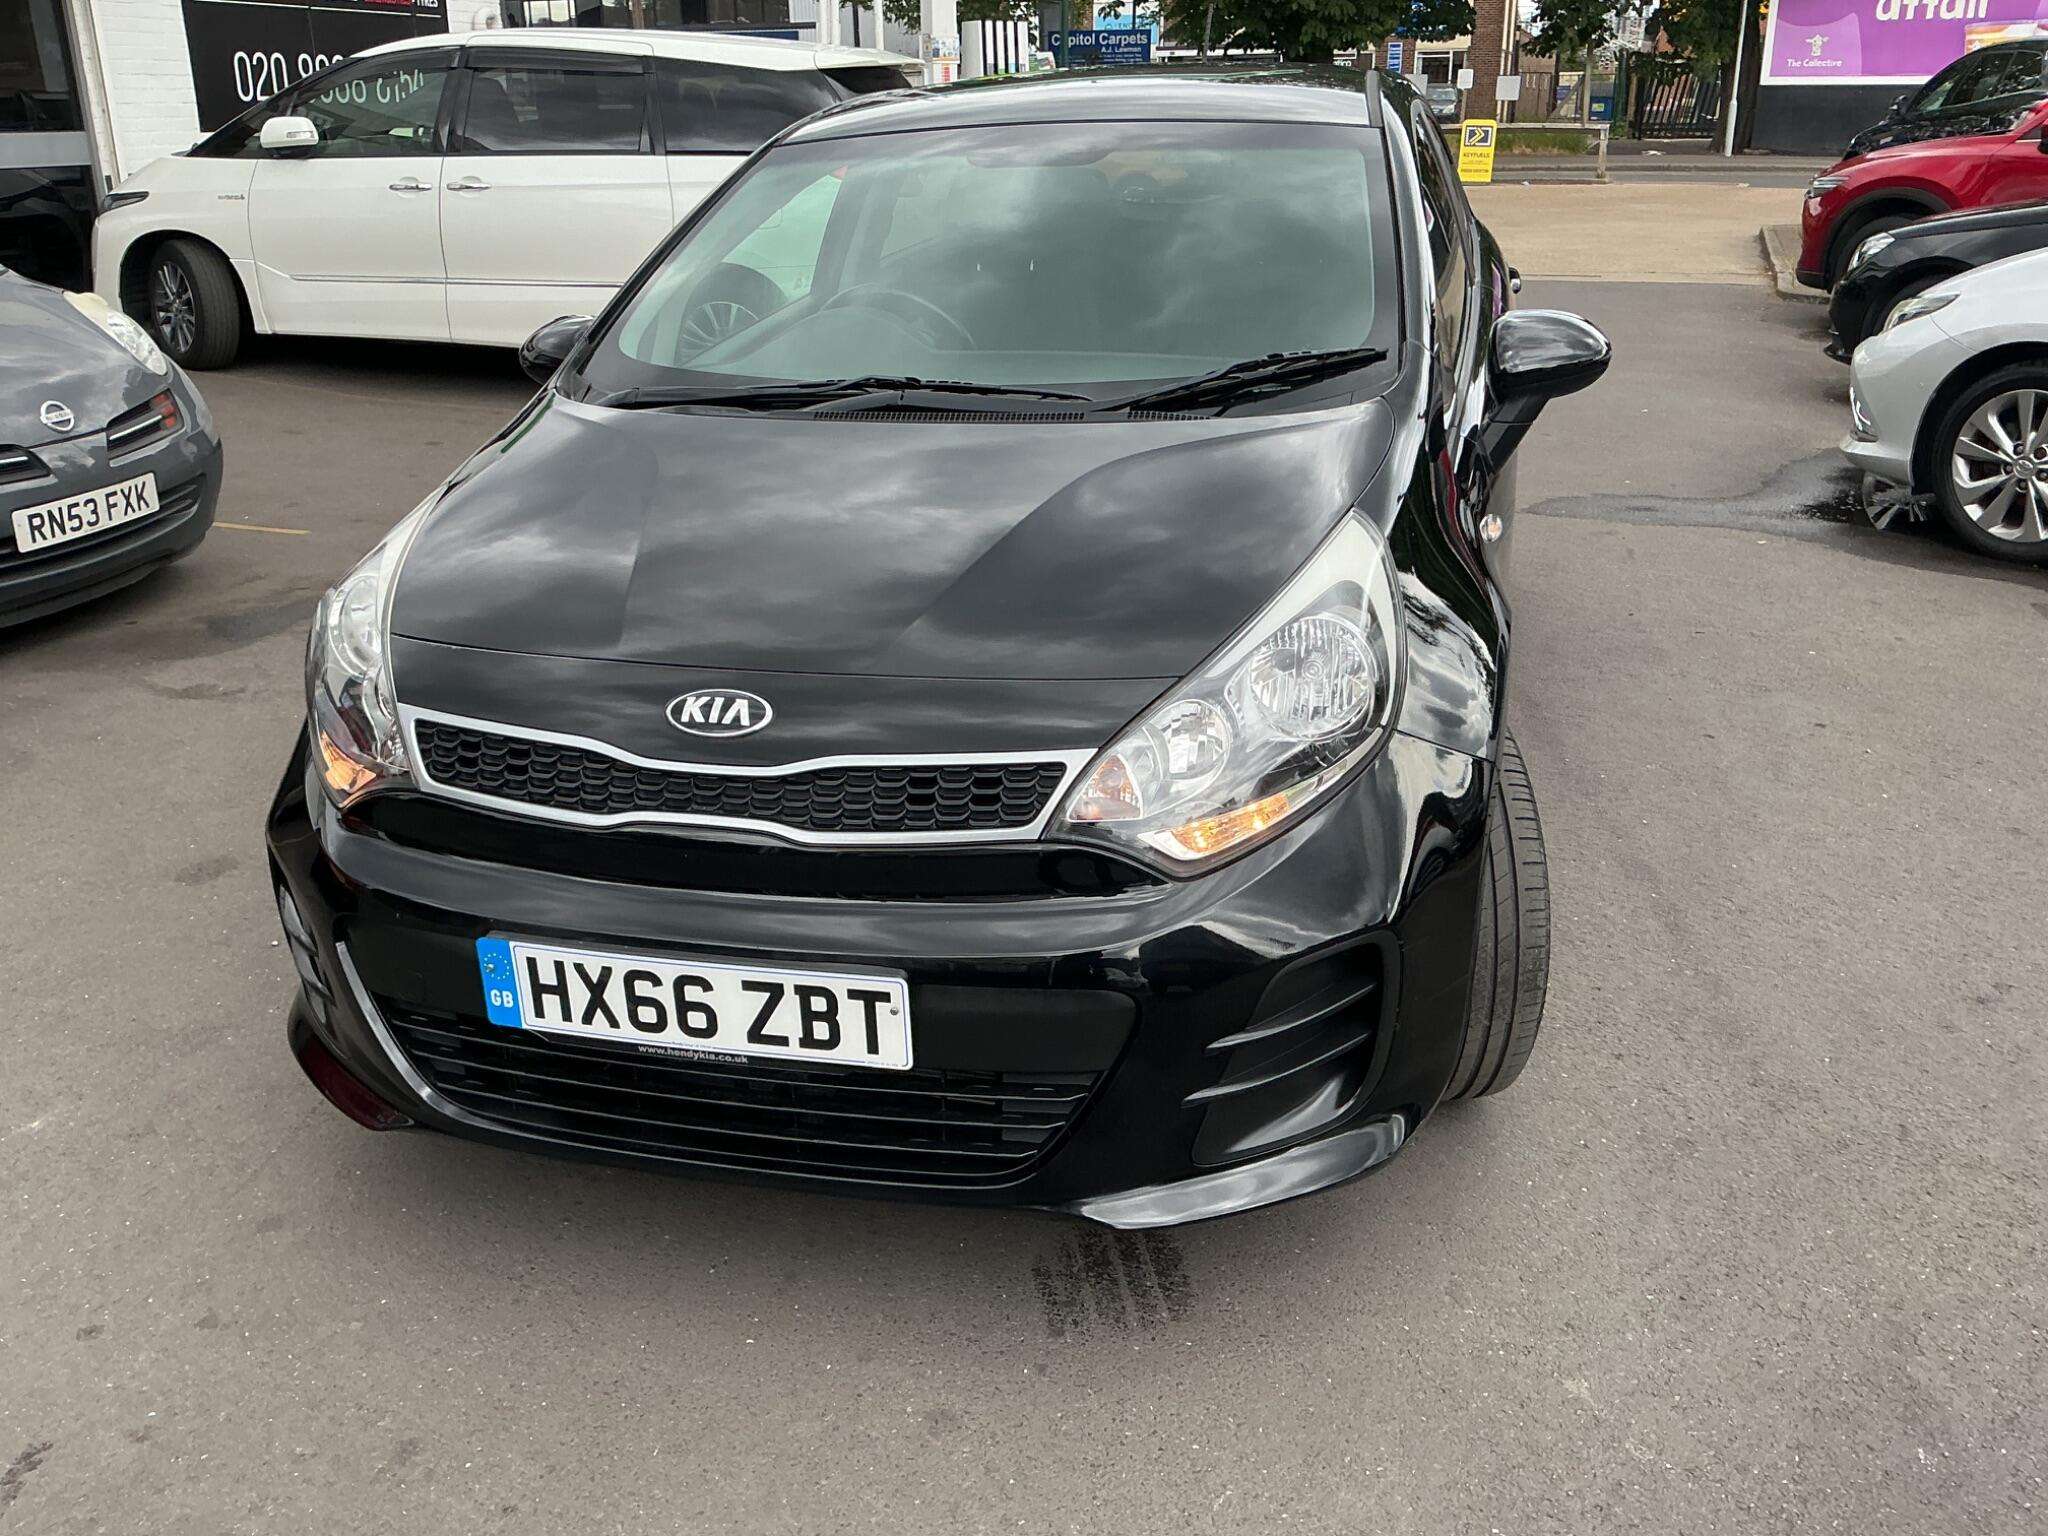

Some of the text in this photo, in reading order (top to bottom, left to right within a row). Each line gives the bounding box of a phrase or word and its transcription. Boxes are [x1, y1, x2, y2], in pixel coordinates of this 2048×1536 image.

[1051, 33, 1148, 48] Cpitol Carpets
[1786, 59, 1842, 67] The Collective
[234, 51, 289, 101] 020
[28, 481, 150, 544] RN53 FXK
[681, 696, 750, 726] KIA
[490, 990, 514, 1008] GB
[525, 956, 892, 1055] HX66 ZBT
[638, 1045, 748, 1064] www.hendykia.co.uk
